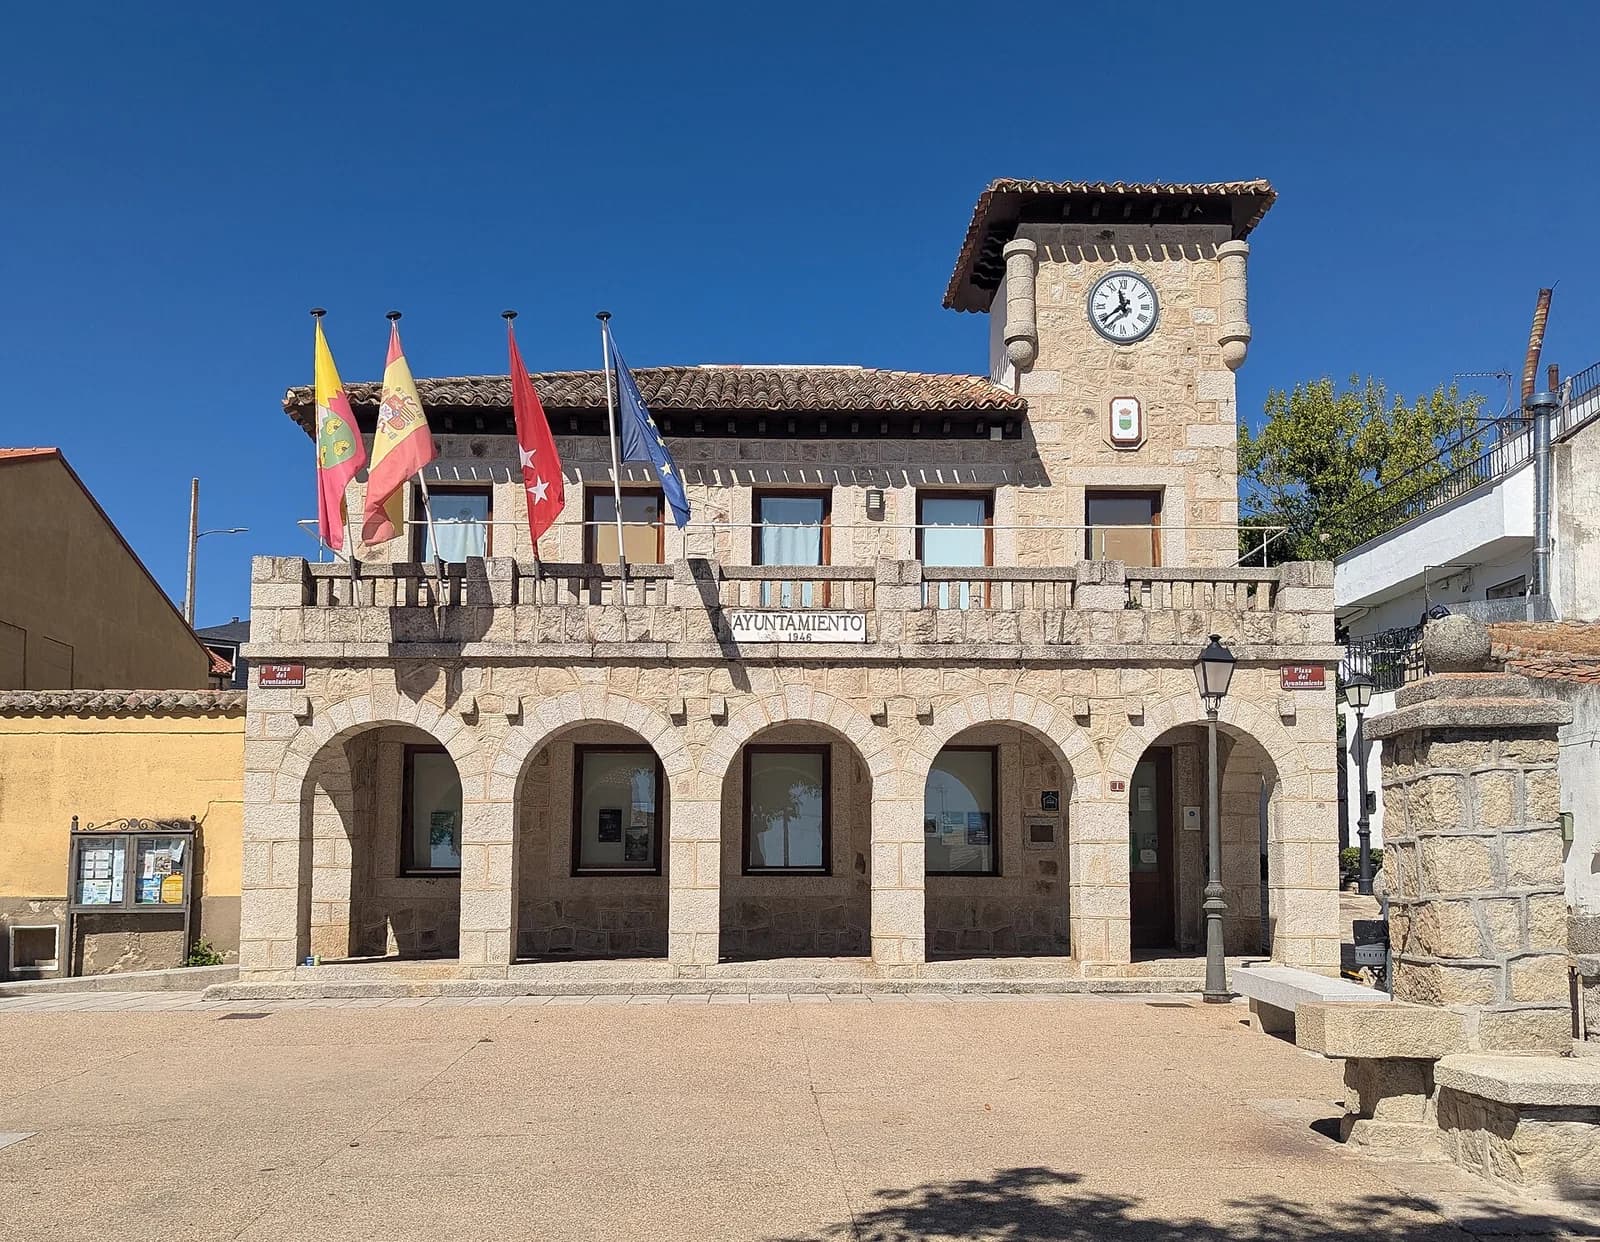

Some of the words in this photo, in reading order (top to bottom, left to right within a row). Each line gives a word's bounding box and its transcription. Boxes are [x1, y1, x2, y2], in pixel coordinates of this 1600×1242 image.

[1118, 280, 1128, 290] XII
[733, 615, 863, 631] AYUNTAMIENTO
[788, 632, 812, 641] 1946
